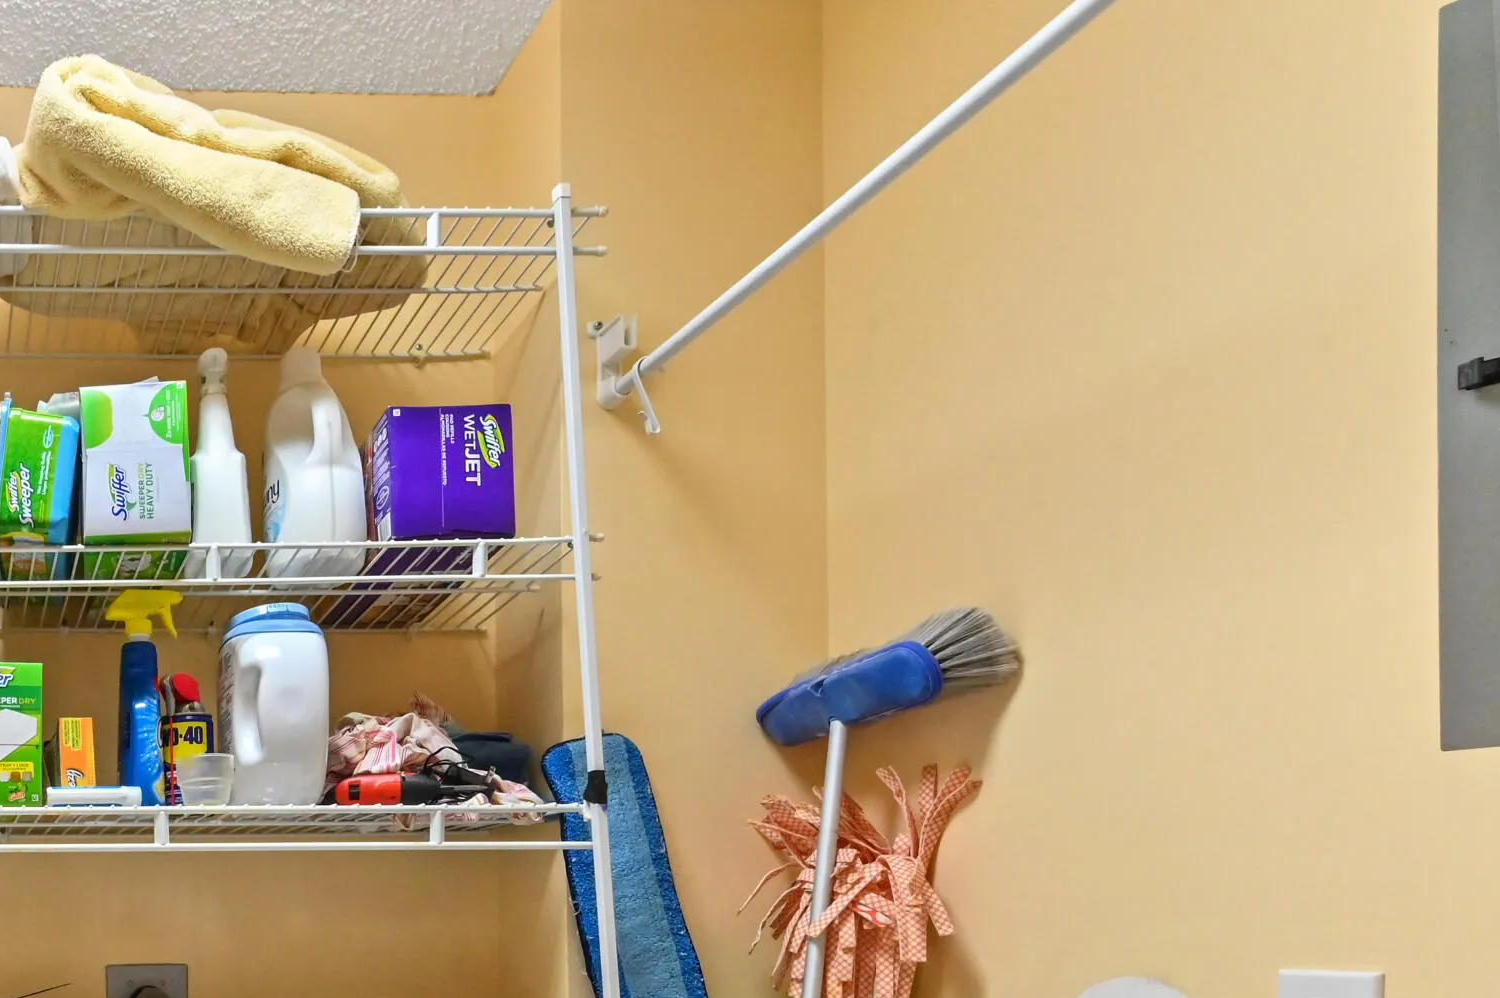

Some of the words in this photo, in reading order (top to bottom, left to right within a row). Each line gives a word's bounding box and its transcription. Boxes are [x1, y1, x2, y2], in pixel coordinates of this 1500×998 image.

[463, 414, 482, 487] WETJET
[479, 416, 502, 467] Swiffer
[19, 462, 35, 528] Sweeper
[111, 466, 131, 521] Swiffer
[145, 463, 154, 486] DUTY
[146, 489, 155, 520] HEAVY
[18, 697, 36, 705] DRY
